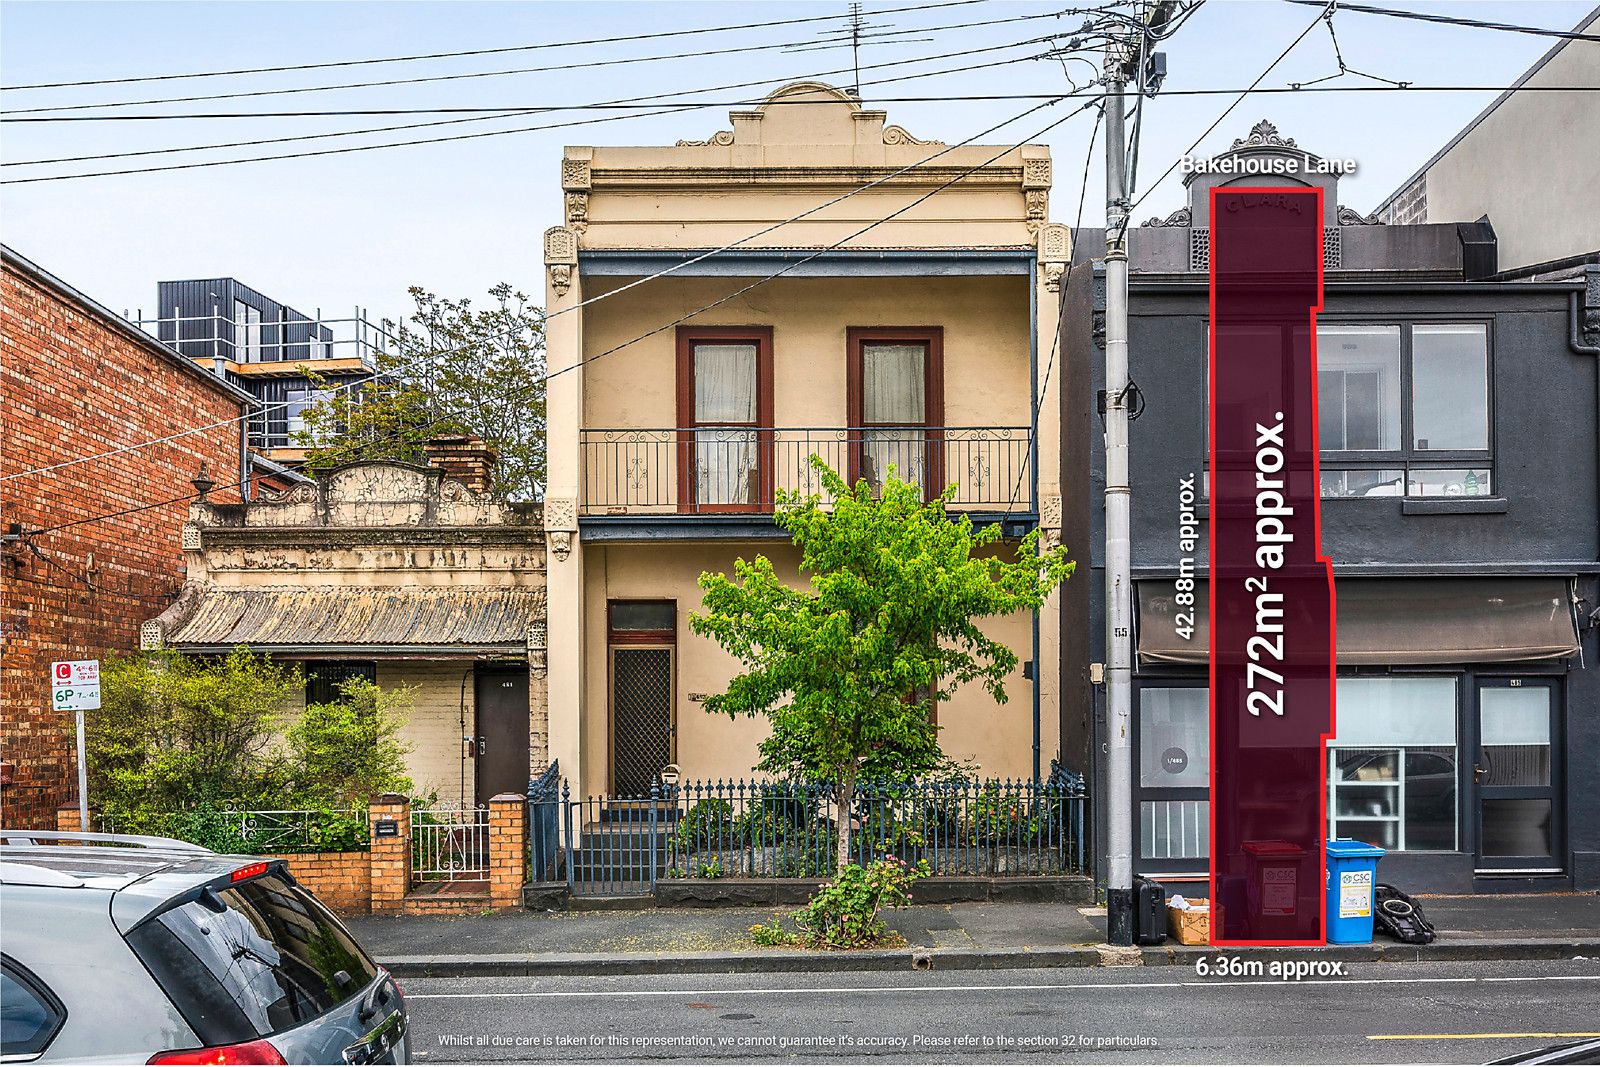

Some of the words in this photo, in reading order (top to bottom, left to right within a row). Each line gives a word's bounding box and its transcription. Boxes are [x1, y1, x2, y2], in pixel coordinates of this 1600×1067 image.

[1225, 194, 1302, 215] CLARA
[60, 664, 69, 678] C
[56, 689, 74, 702] 6P
[1353, 873, 1370, 882] CSC
